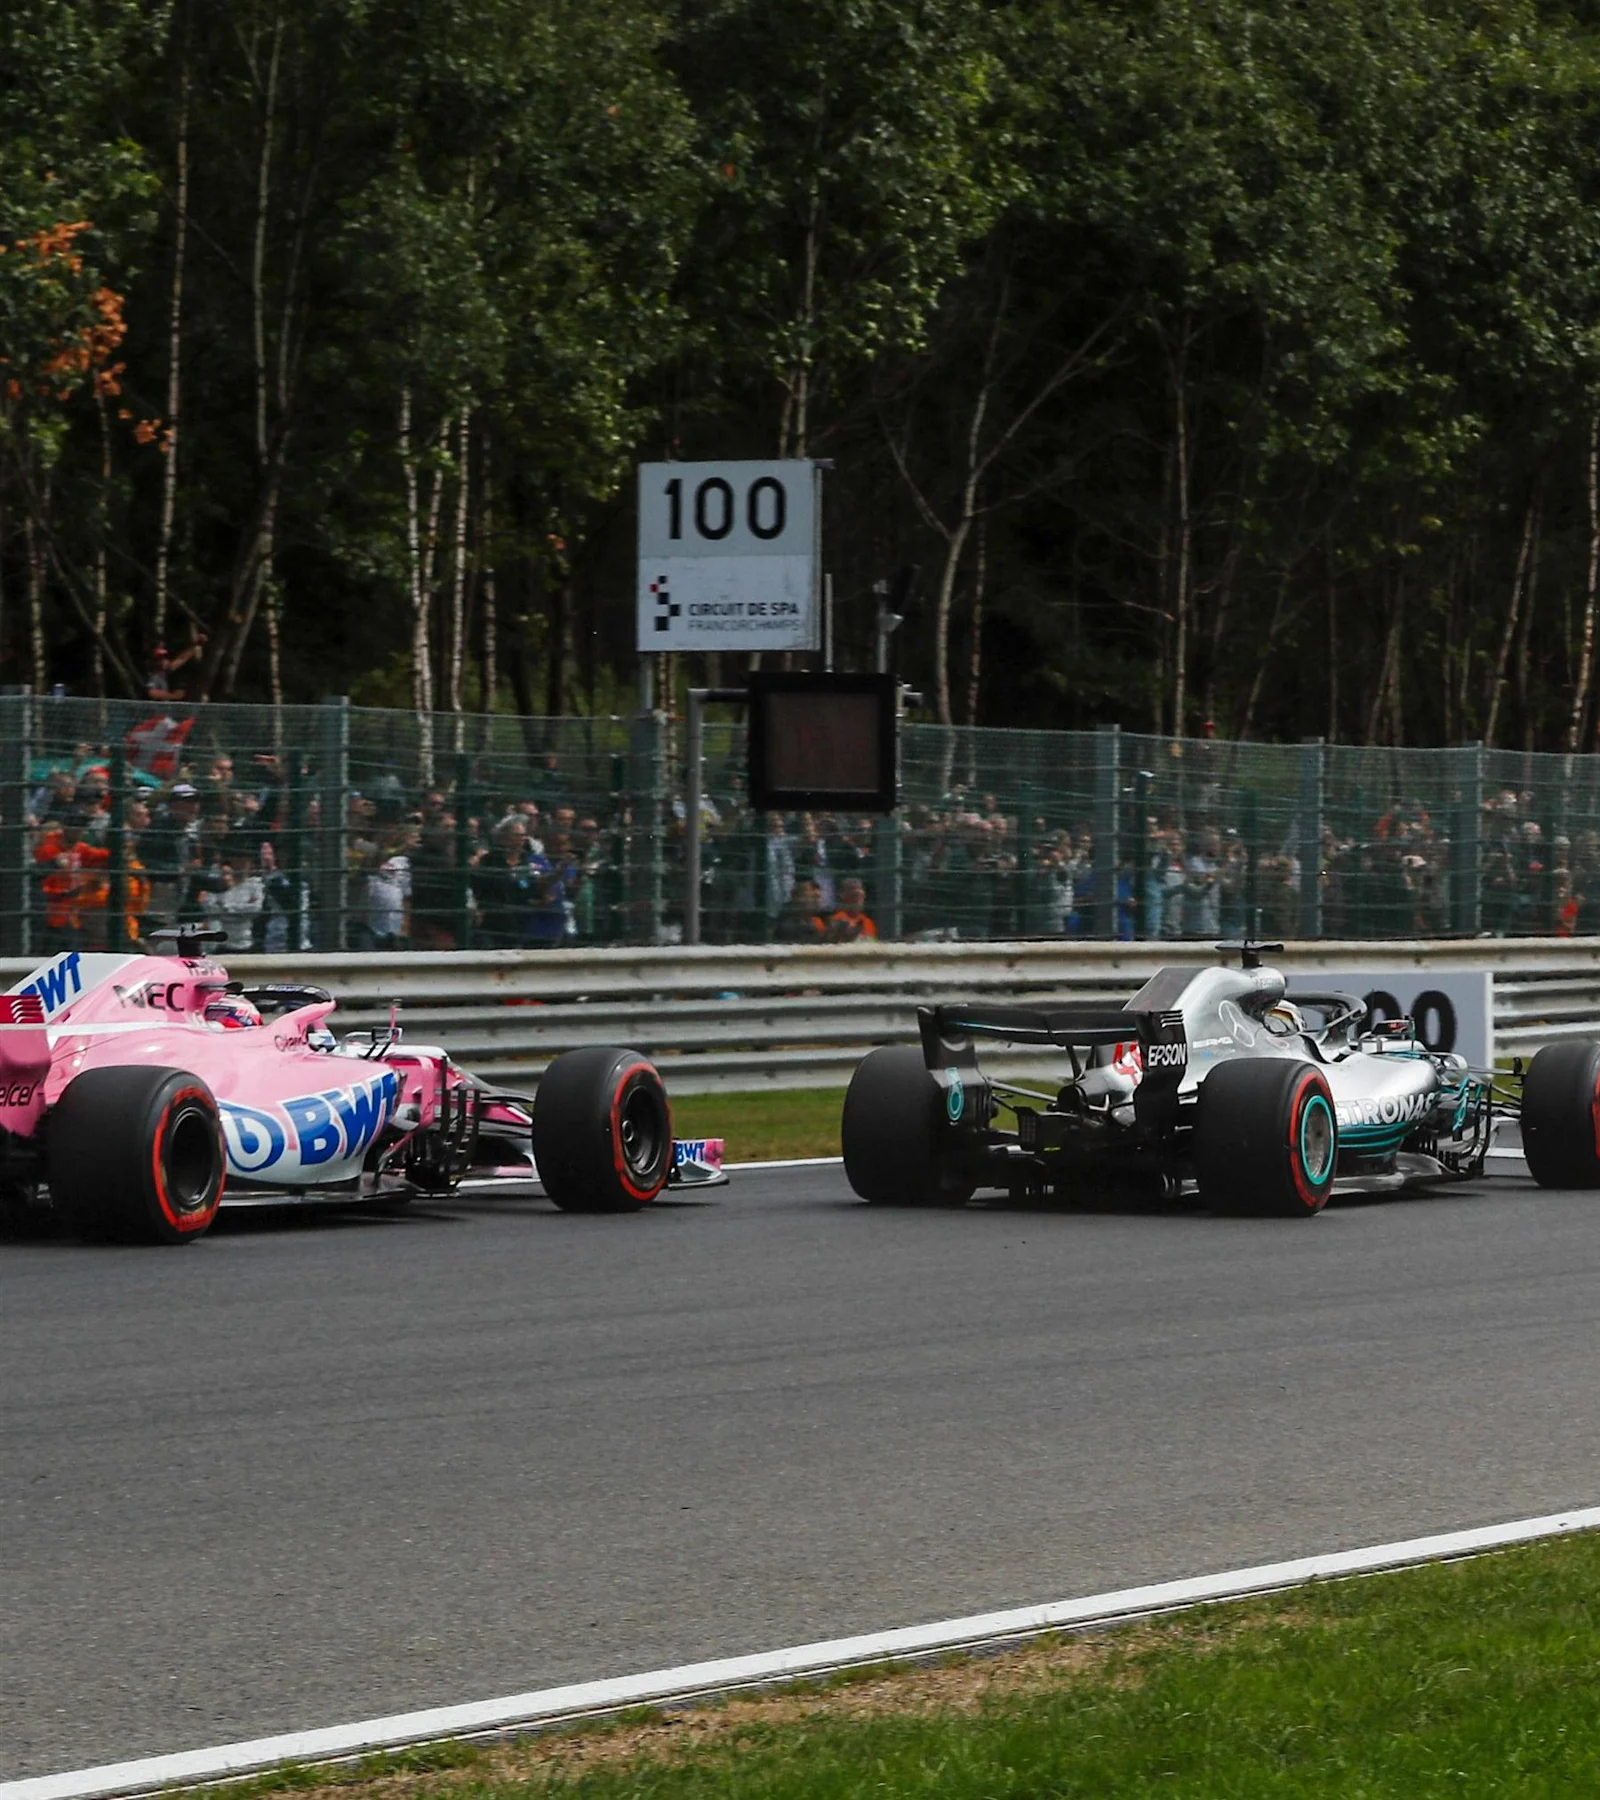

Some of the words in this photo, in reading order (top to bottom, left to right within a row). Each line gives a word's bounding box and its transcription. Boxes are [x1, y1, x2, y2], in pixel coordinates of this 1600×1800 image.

[664, 476, 786, 540] 100
[688, 602, 744, 616] CIRCUIT
[747, 602, 767, 616] DE
[770, 602, 800, 616] SPA
[688, 619, 800, 631] FRANCORCHAMPS
[1326, 990, 1457, 1053] 00
[1148, 1043, 1187, 1066] EPSON
[279, 1072, 397, 1165] BWT
[676, 1142, 705, 1164] BWT
